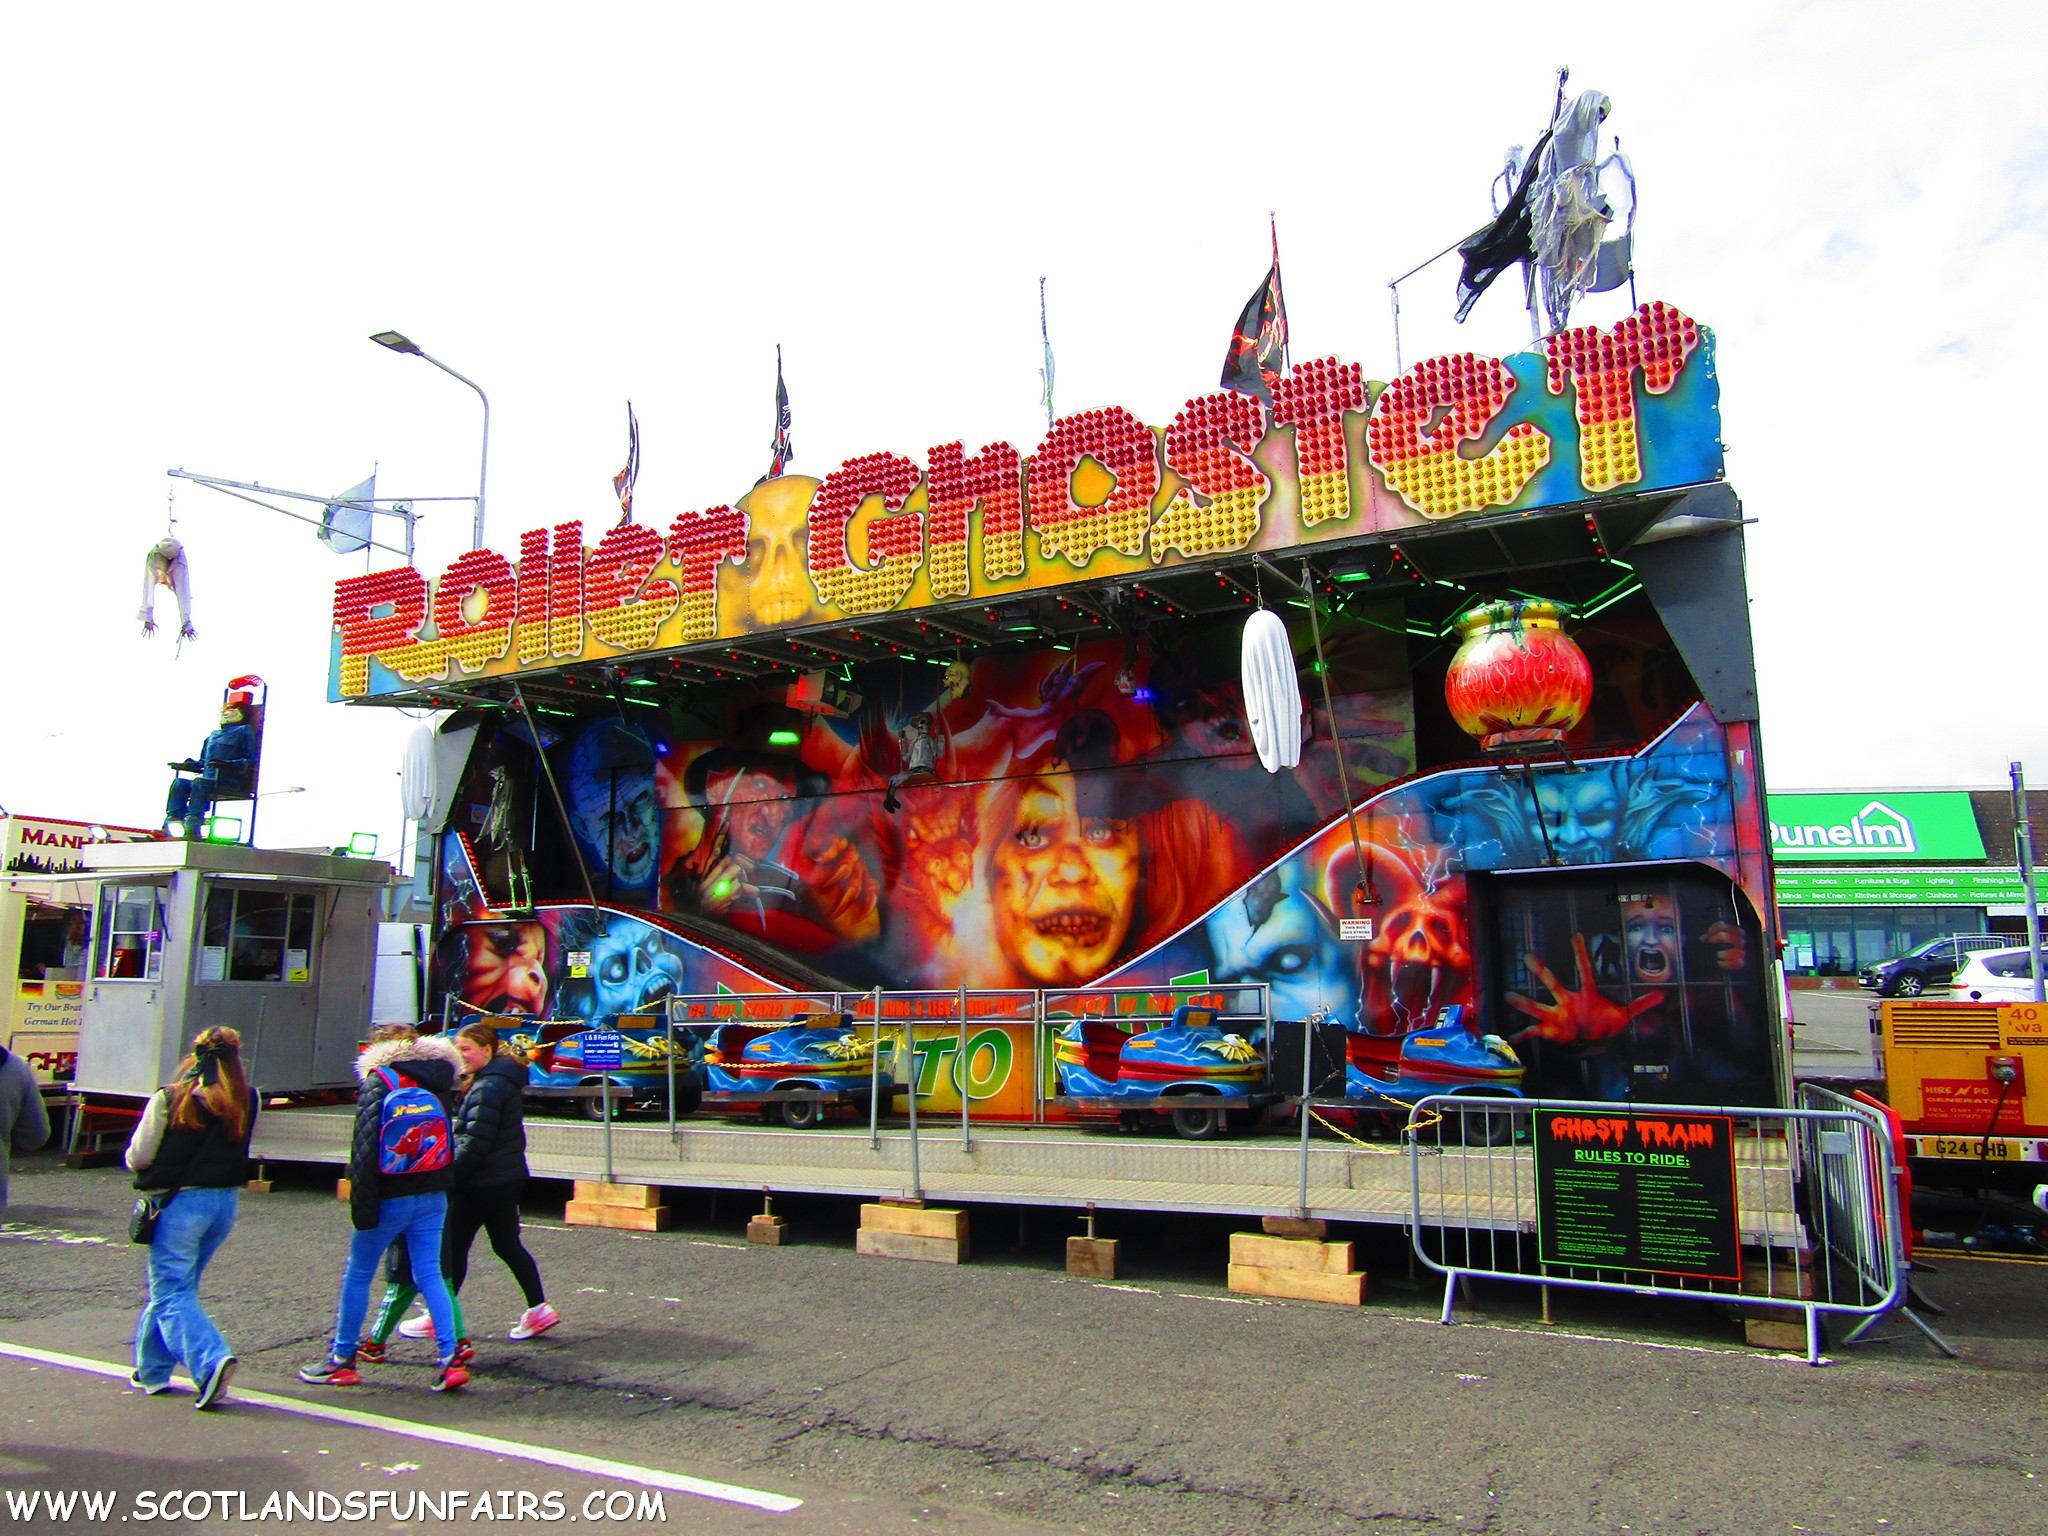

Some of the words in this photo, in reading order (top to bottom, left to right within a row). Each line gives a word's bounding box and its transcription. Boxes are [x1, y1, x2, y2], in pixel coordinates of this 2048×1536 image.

[1892, 878, 1910, 886] Rugs
[1925, 877, 1955, 885] Lighting
[27, 1003, 41, 1013] Try
[44, 1003, 61, 1011] Our
[63, 1003, 82, 1012] Brat
[712, 1003, 736, 1018] NOT
[742, 1002, 783, 1018] STAND
[790, 1002, 809, 1015] UP
[856, 1000, 876, 1016] KEE
[882, 1000, 911, 1016] ARMS
[927, 1000, 951, 1016] LEGS
[1075, 996, 1109, 1014] PAY
[1118, 997, 1137, 1013] IN
[1147, 995, 1177, 1013] THE
[1189, 994, 1225, 1011] CAR
[24, 1017, 58, 1026] German
[60, 1017, 77, 1026] Hot
[2010, 1008, 2037, 1020] 40
[916, 1027, 1014, 1100] TO
[1925, 1086, 1953, 1094] HIRE
[1974, 1087, 1989, 1095] PO
[1551, 1117, 1629, 1148] GHOST
[1635, 1119, 1714, 1151] TRAIN
[1936, 1140, 1968, 1155] G24
[1574, 1149, 1621, 1163] RULES
[1624, 1152, 1646, 1164] TO
[1649, 1153, 1690, 1167] RIDE:
